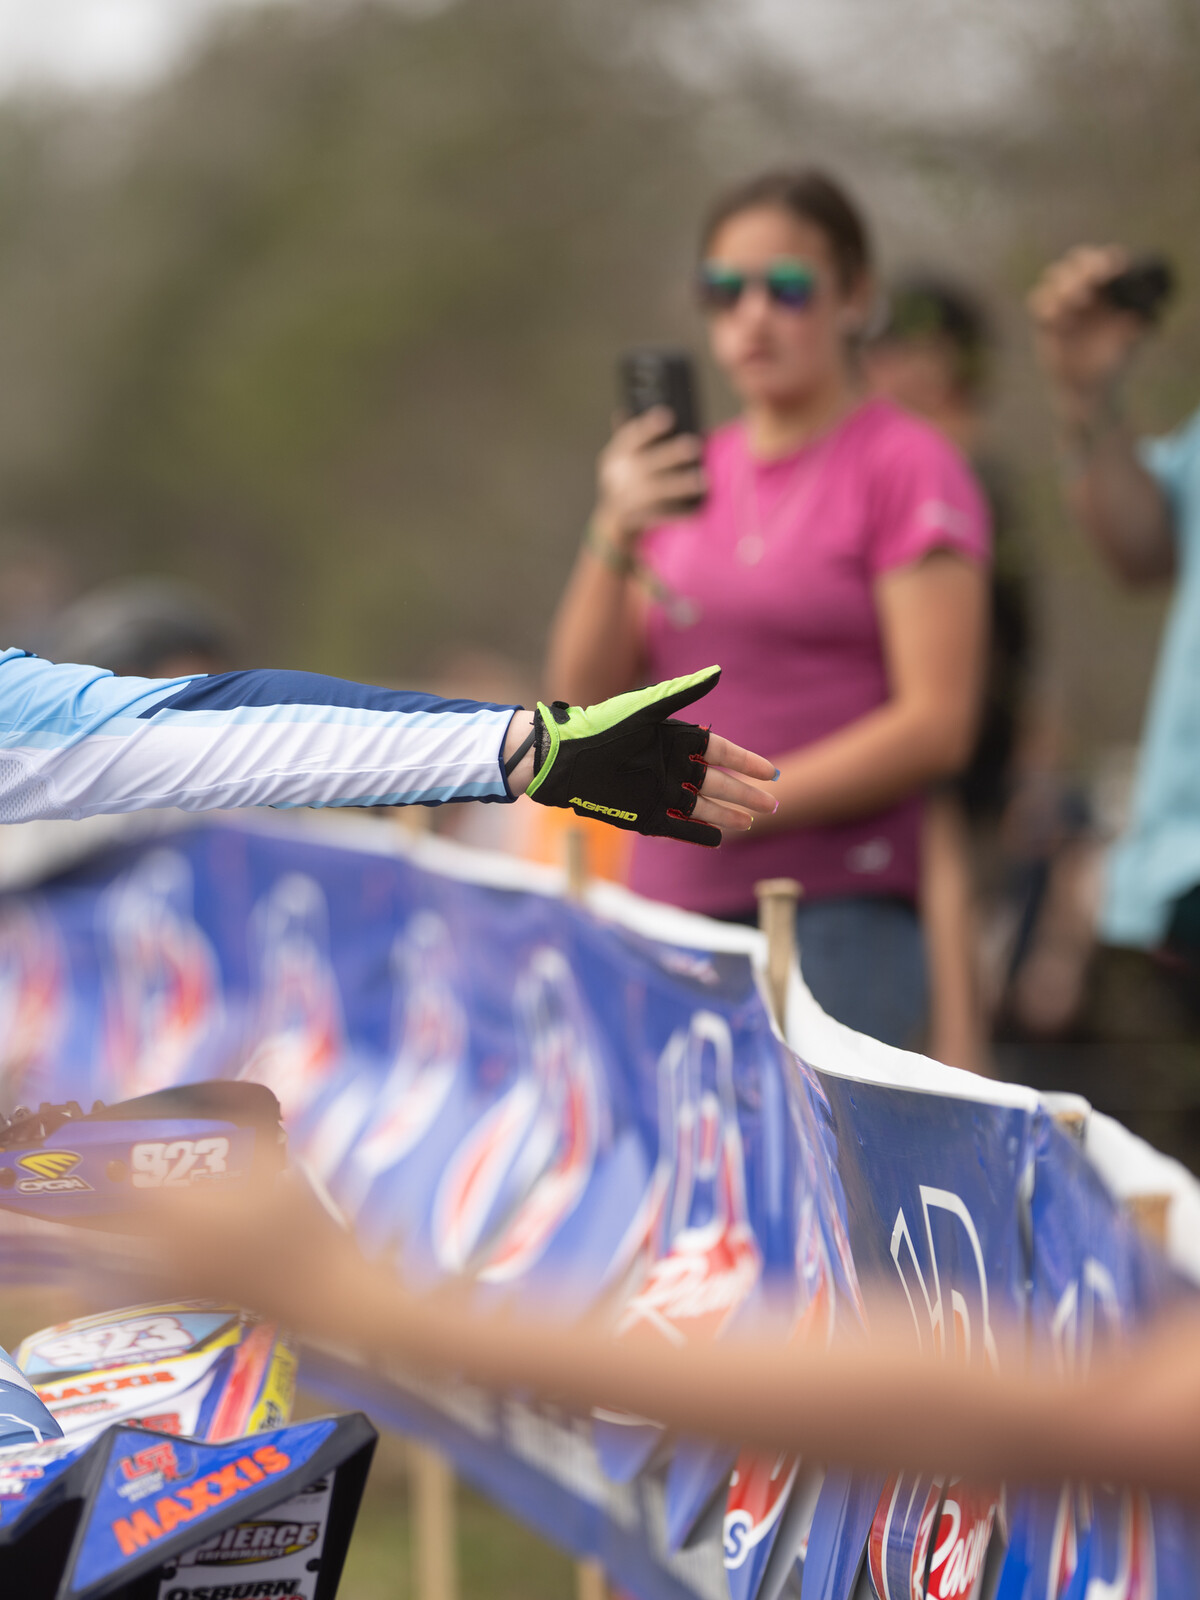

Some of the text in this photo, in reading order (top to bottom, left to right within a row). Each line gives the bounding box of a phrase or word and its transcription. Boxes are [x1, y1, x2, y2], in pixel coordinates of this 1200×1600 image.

[569, 796, 638, 821] AGROID
[131, 1137, 229, 1188] 923
[33, 1317, 195, 1366] 923
[112, 1445, 291, 1556] MAXXIS
